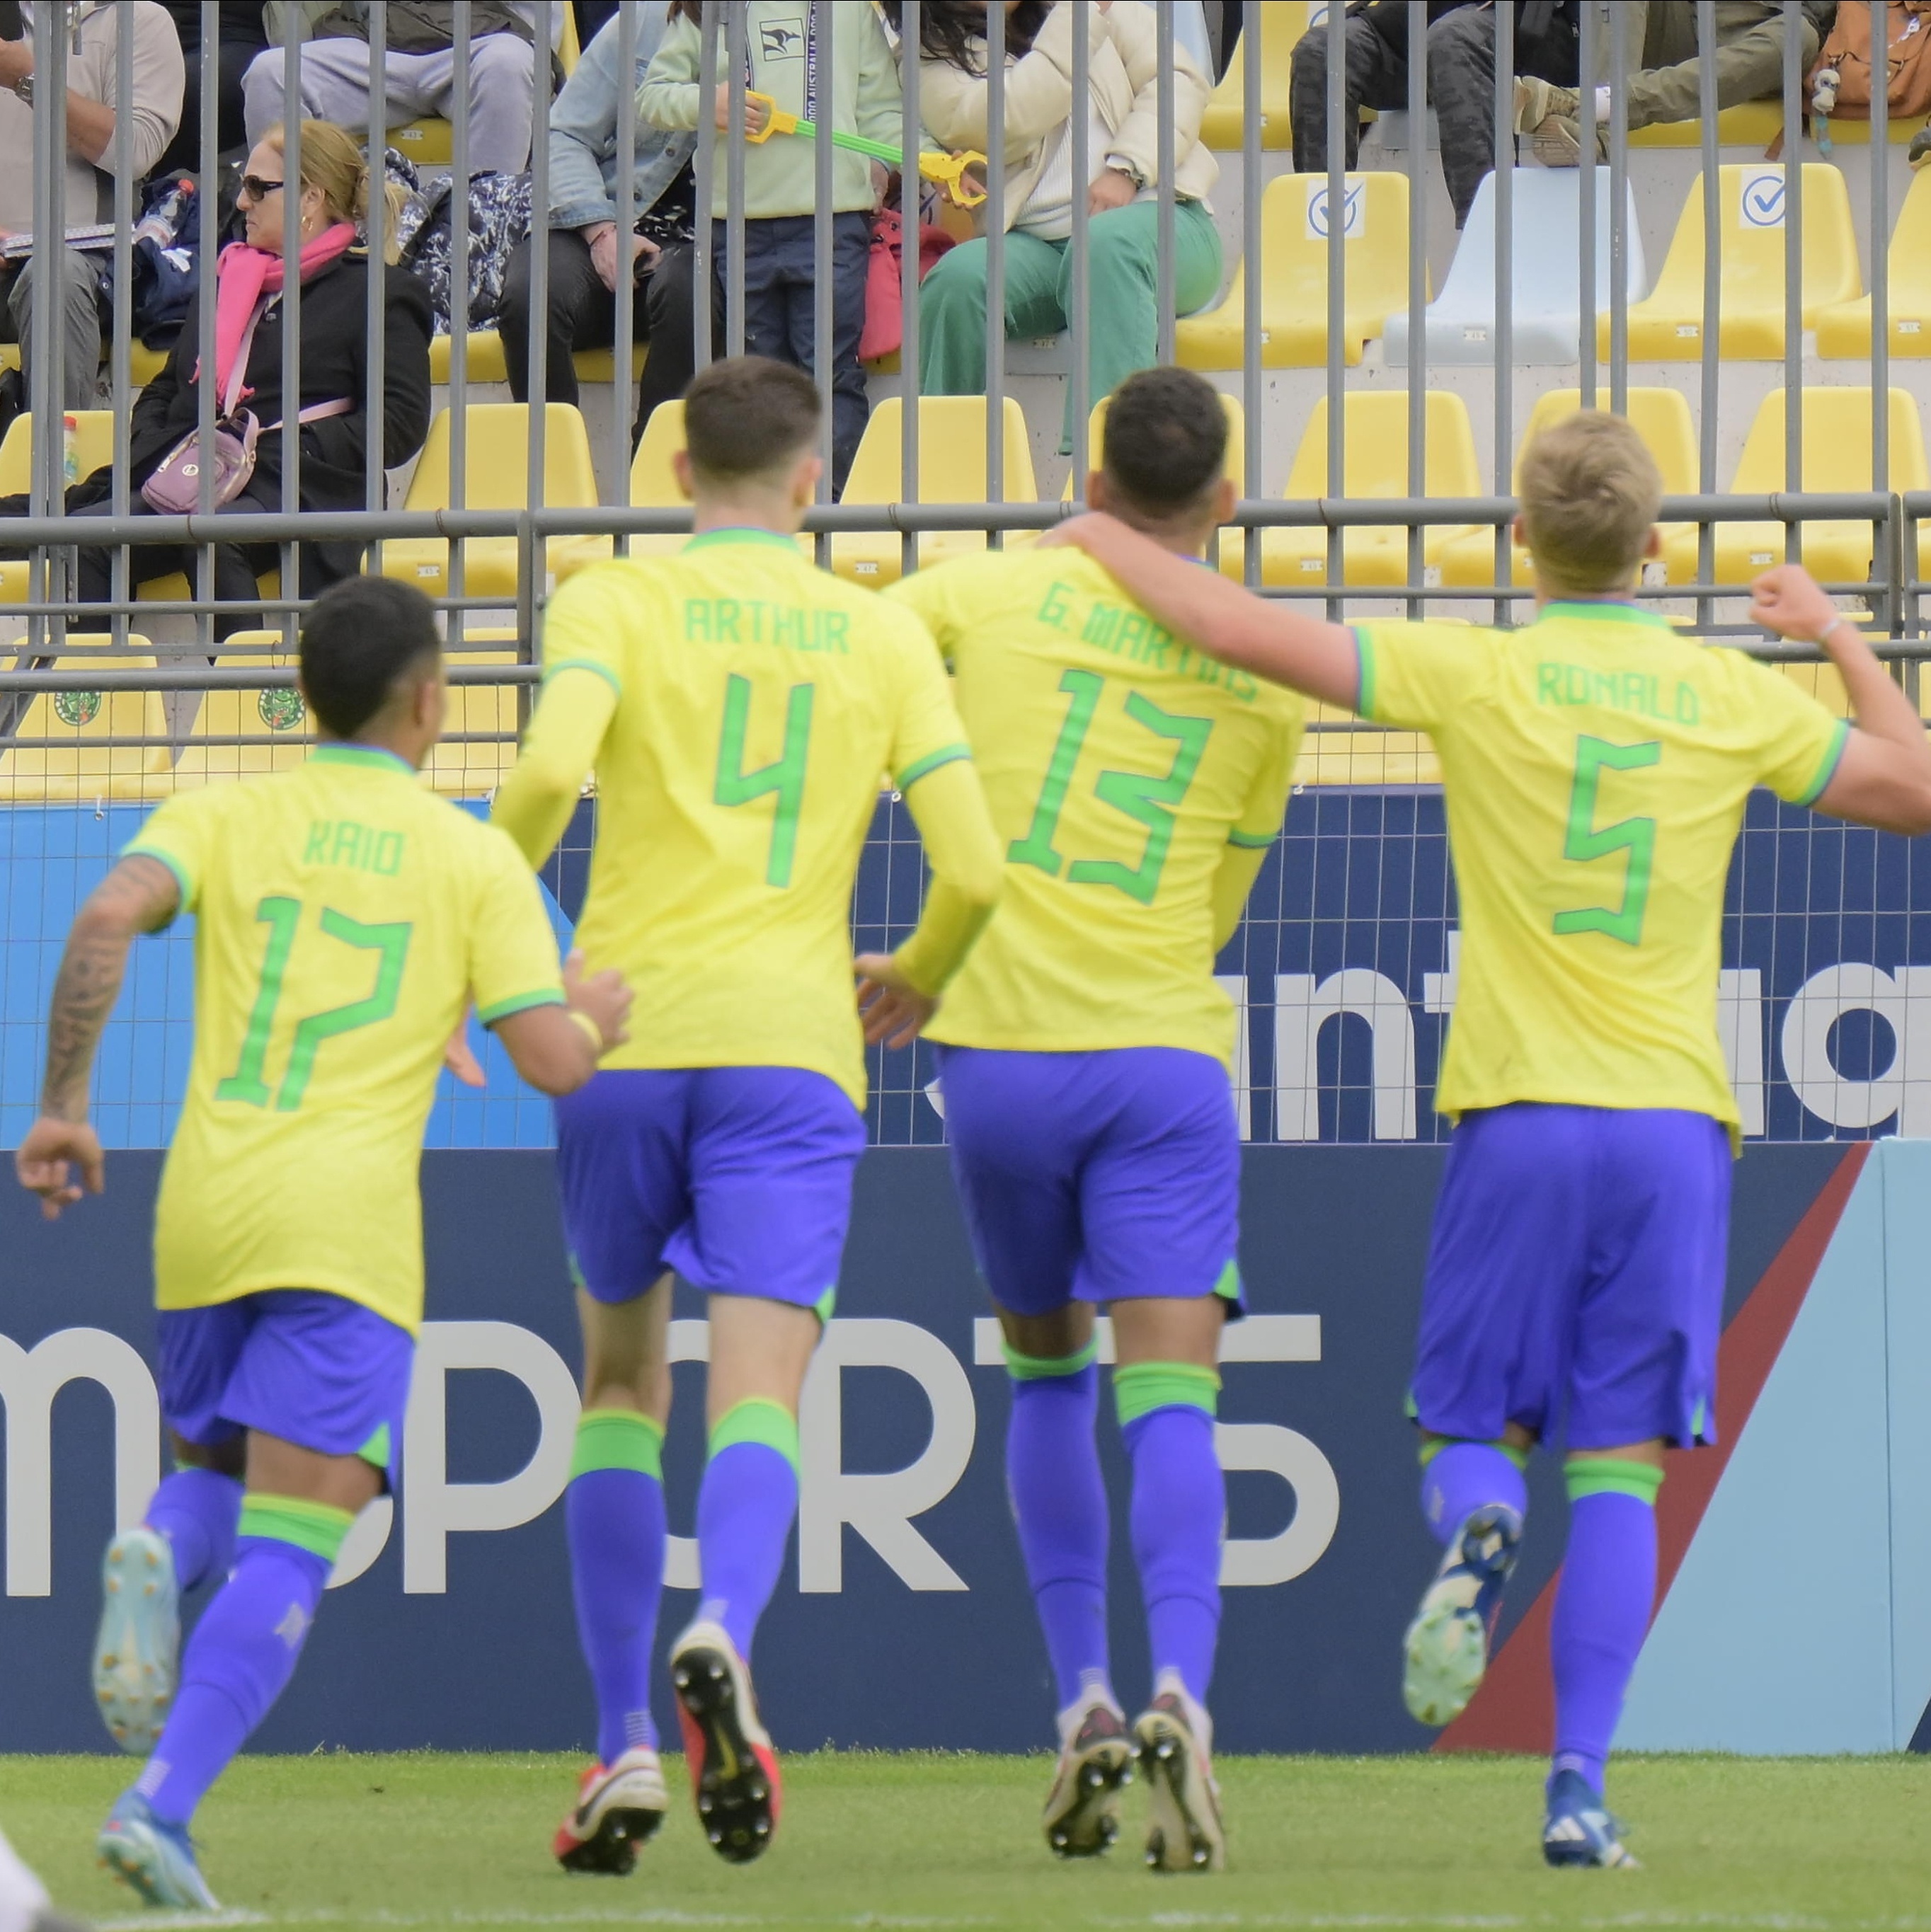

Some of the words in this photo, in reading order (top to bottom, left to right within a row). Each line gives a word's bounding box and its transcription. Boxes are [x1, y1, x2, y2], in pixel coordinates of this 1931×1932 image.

[684, 599, 851, 654] ARTHUR
[1537, 662, 1700, 727] RONALD
[302, 820, 406, 877] KAIO
[714, 672, 815, 889] 4
[1007, 668, 1215, 907] 13
[1552, 732, 1661, 946] 5
[214, 895, 414, 1112] 17
